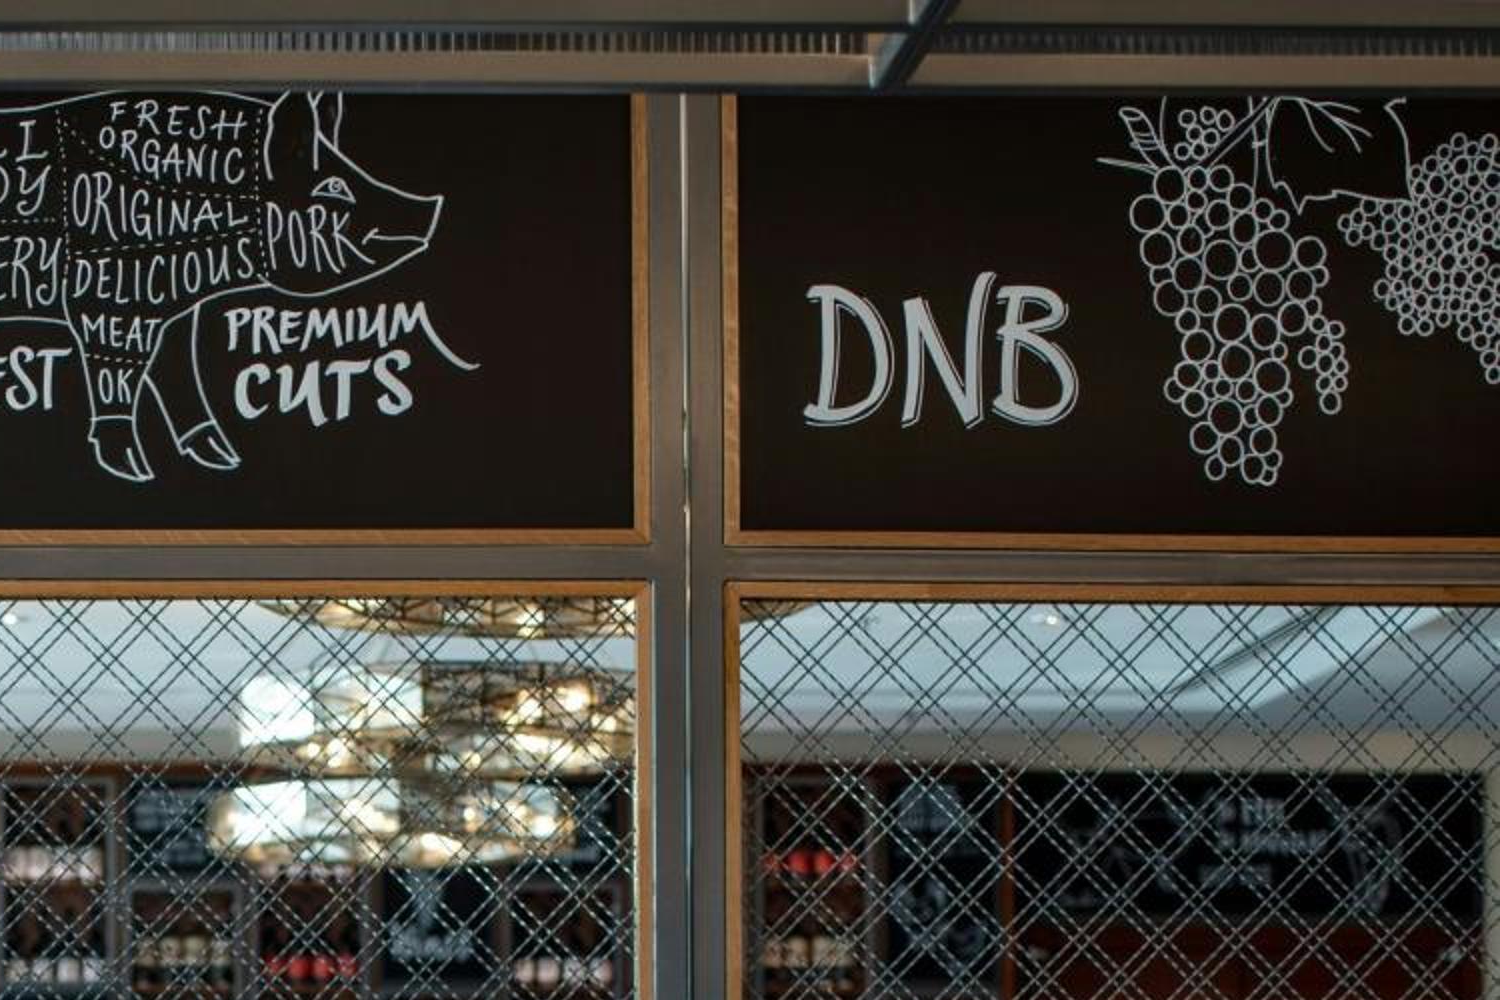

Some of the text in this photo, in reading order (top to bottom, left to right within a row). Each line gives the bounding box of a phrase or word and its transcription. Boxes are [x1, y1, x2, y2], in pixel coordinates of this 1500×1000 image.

[110, 100, 247, 140] FRESH
[99, 126, 244, 184] ORGANIC
[73, 172, 248, 241] ORIGINAL
[266, 202, 375, 273] PORK
[73, 238, 253, 303] DELICIOUS
[80, 314, 161, 352] MEAT
[224, 301, 480, 370] PREMIUM
[804, 272, 1078, 429] DNB
[98, 368, 133, 404] OK
[235, 350, 412, 427] CUTS
